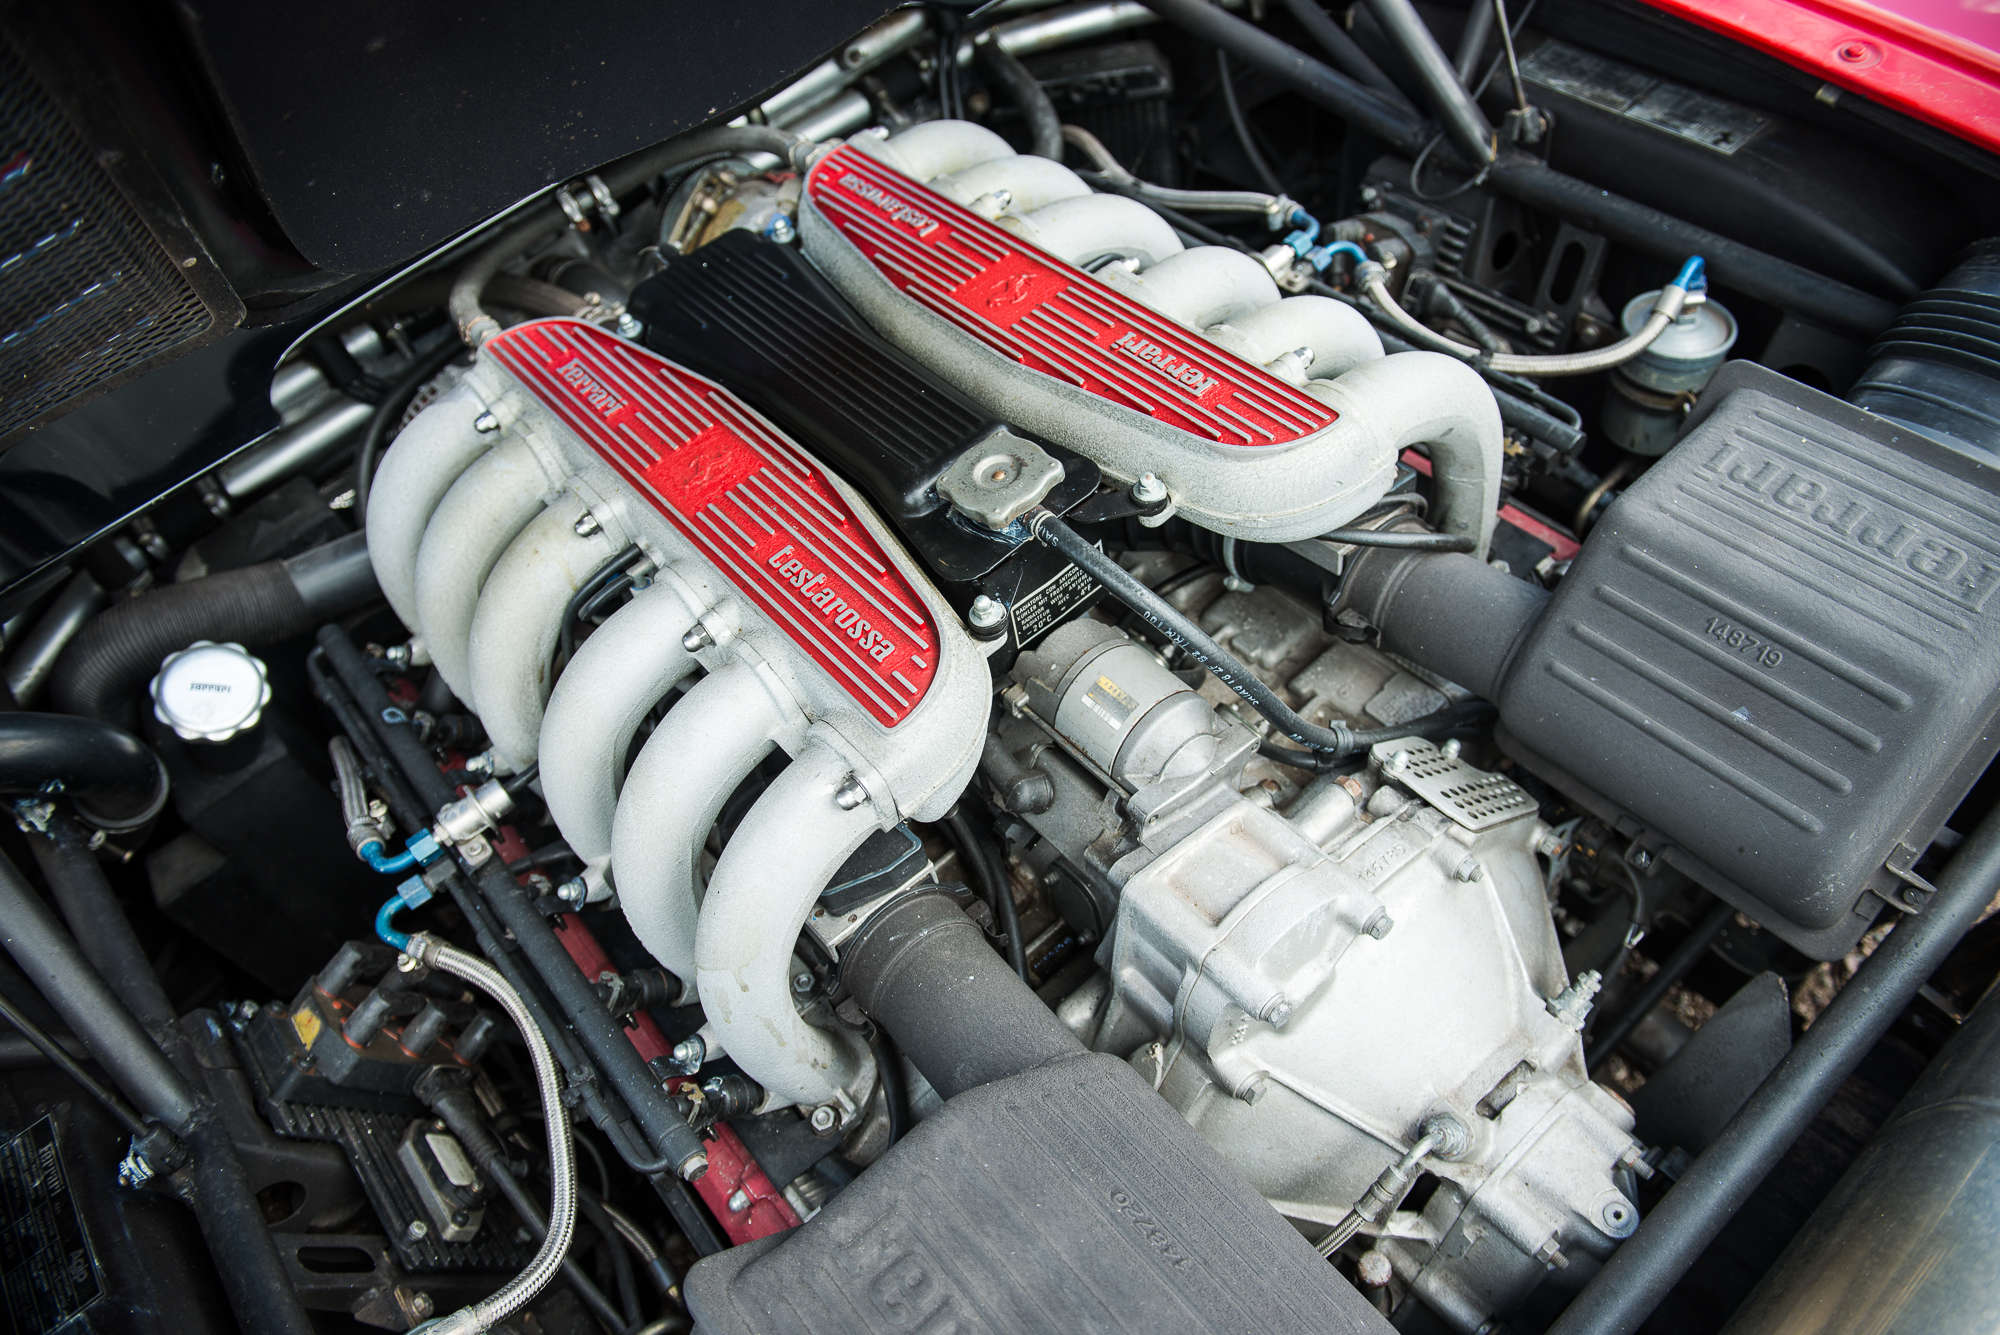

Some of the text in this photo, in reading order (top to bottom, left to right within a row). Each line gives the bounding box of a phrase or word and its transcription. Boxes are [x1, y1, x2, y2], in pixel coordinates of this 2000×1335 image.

[839, 173, 939, 237] testarossa
[556, 358, 628, 417] Ferrari
[1110, 331, 1219, 397] Ferrari
[1693, 442, 2000, 613] Ferrari
[768, 545, 895, 662] testarossa
[1016, 594, 1042, 615] RADIATORE
[1045, 584, 1056, 595] CON
[1021, 606, 1045, 626] RADIATOR
[1050, 593, 1063, 605] WITH
[1022, 609, 1050, 631] RADIATEUR
[1057, 594, 1070, 606] AVEC
[1038, 597, 1048, 607] MIT
[1704, 615, 1784, 669] 148719
